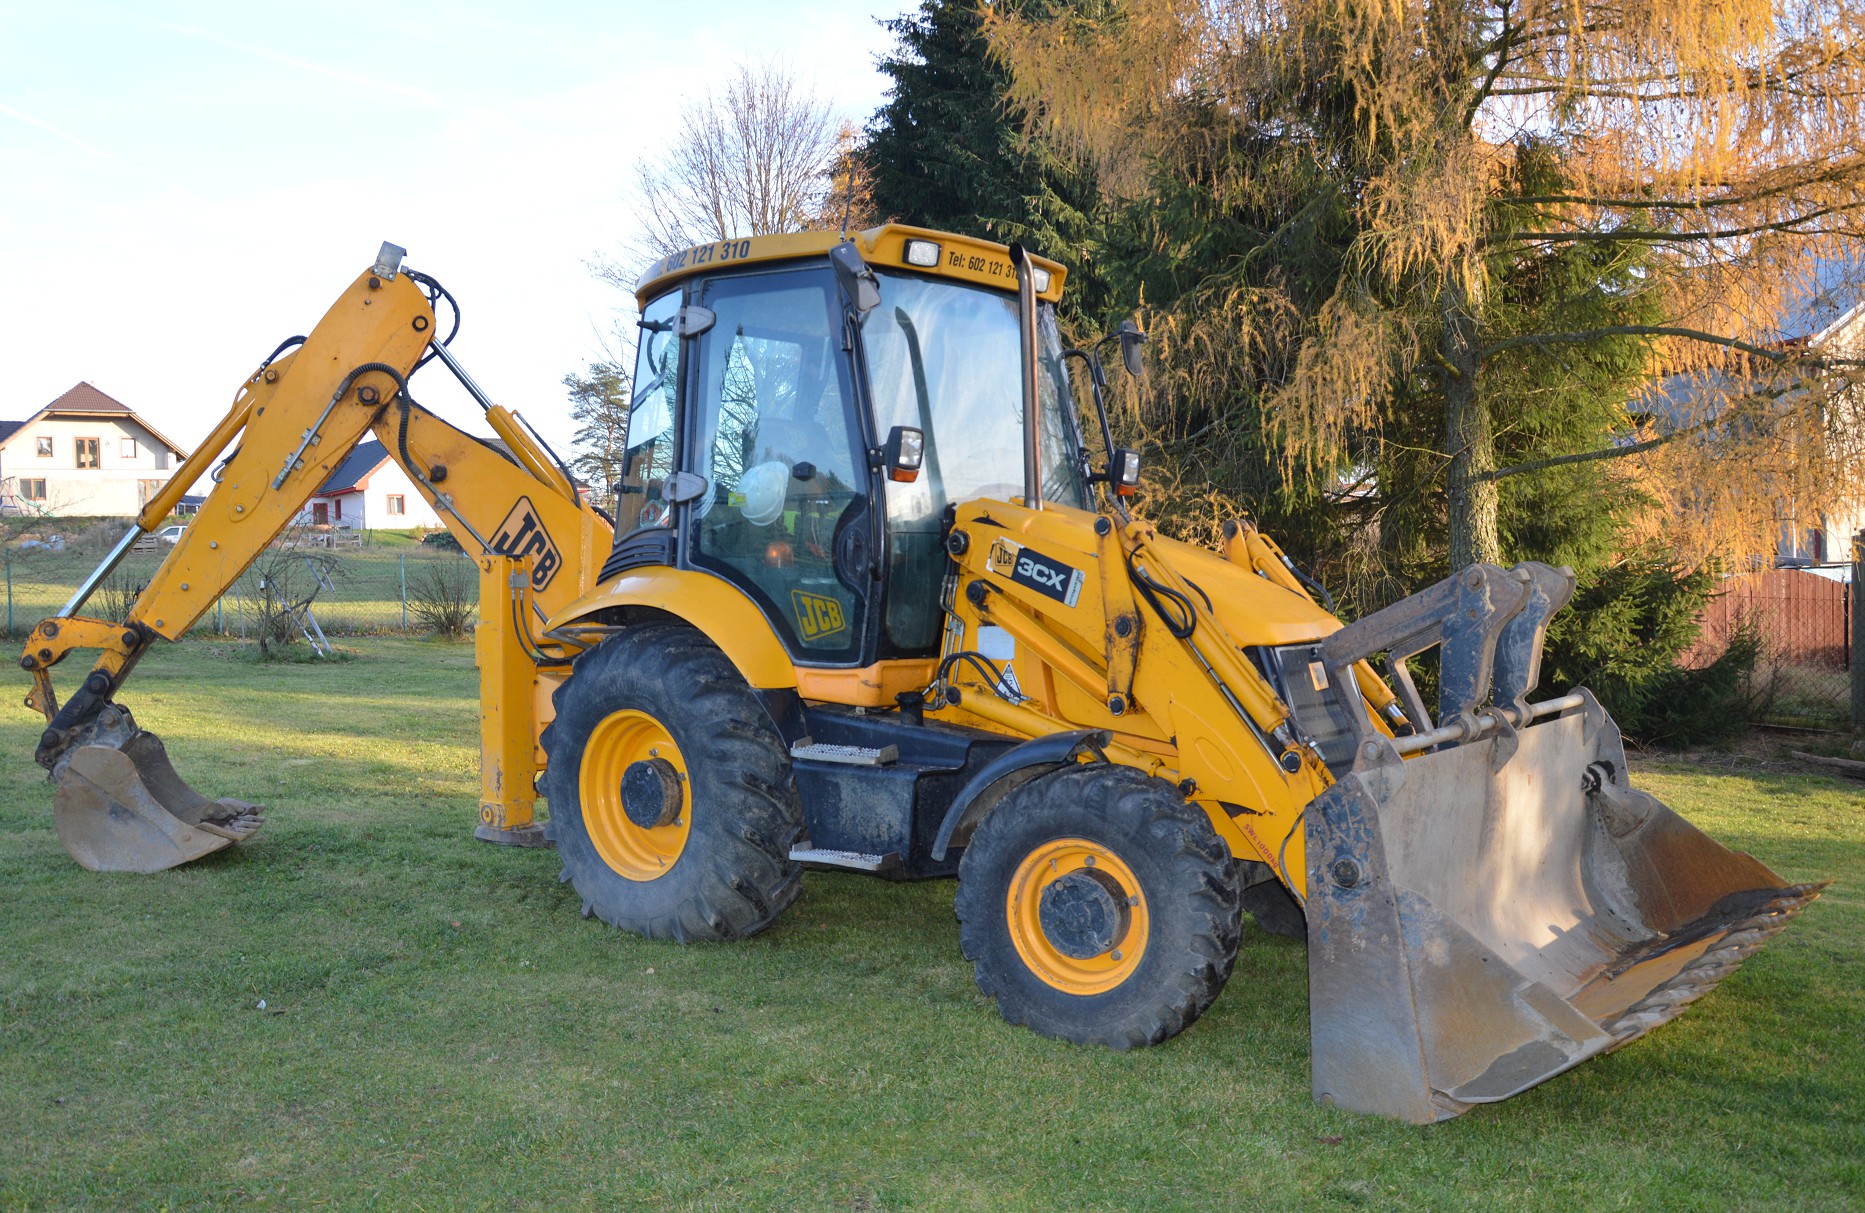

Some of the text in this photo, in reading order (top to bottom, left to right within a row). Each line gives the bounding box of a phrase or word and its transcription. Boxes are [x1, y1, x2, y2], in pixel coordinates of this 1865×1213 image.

[667, 251, 688, 272] 602
[692, 245, 715, 265] 121
[720, 240, 751, 260] 310
[949, 251, 966, 268] Tel:
[968, 256, 986, 272] 602
[988, 261, 1004, 276] 121
[493, 511, 556, 585] JCB
[996, 547, 1013, 565] JCB
[1017, 557, 1066, 592] 3CX
[801, 596, 841, 635] JCB
[1244, 824, 1279, 869] SWL 1000kg
